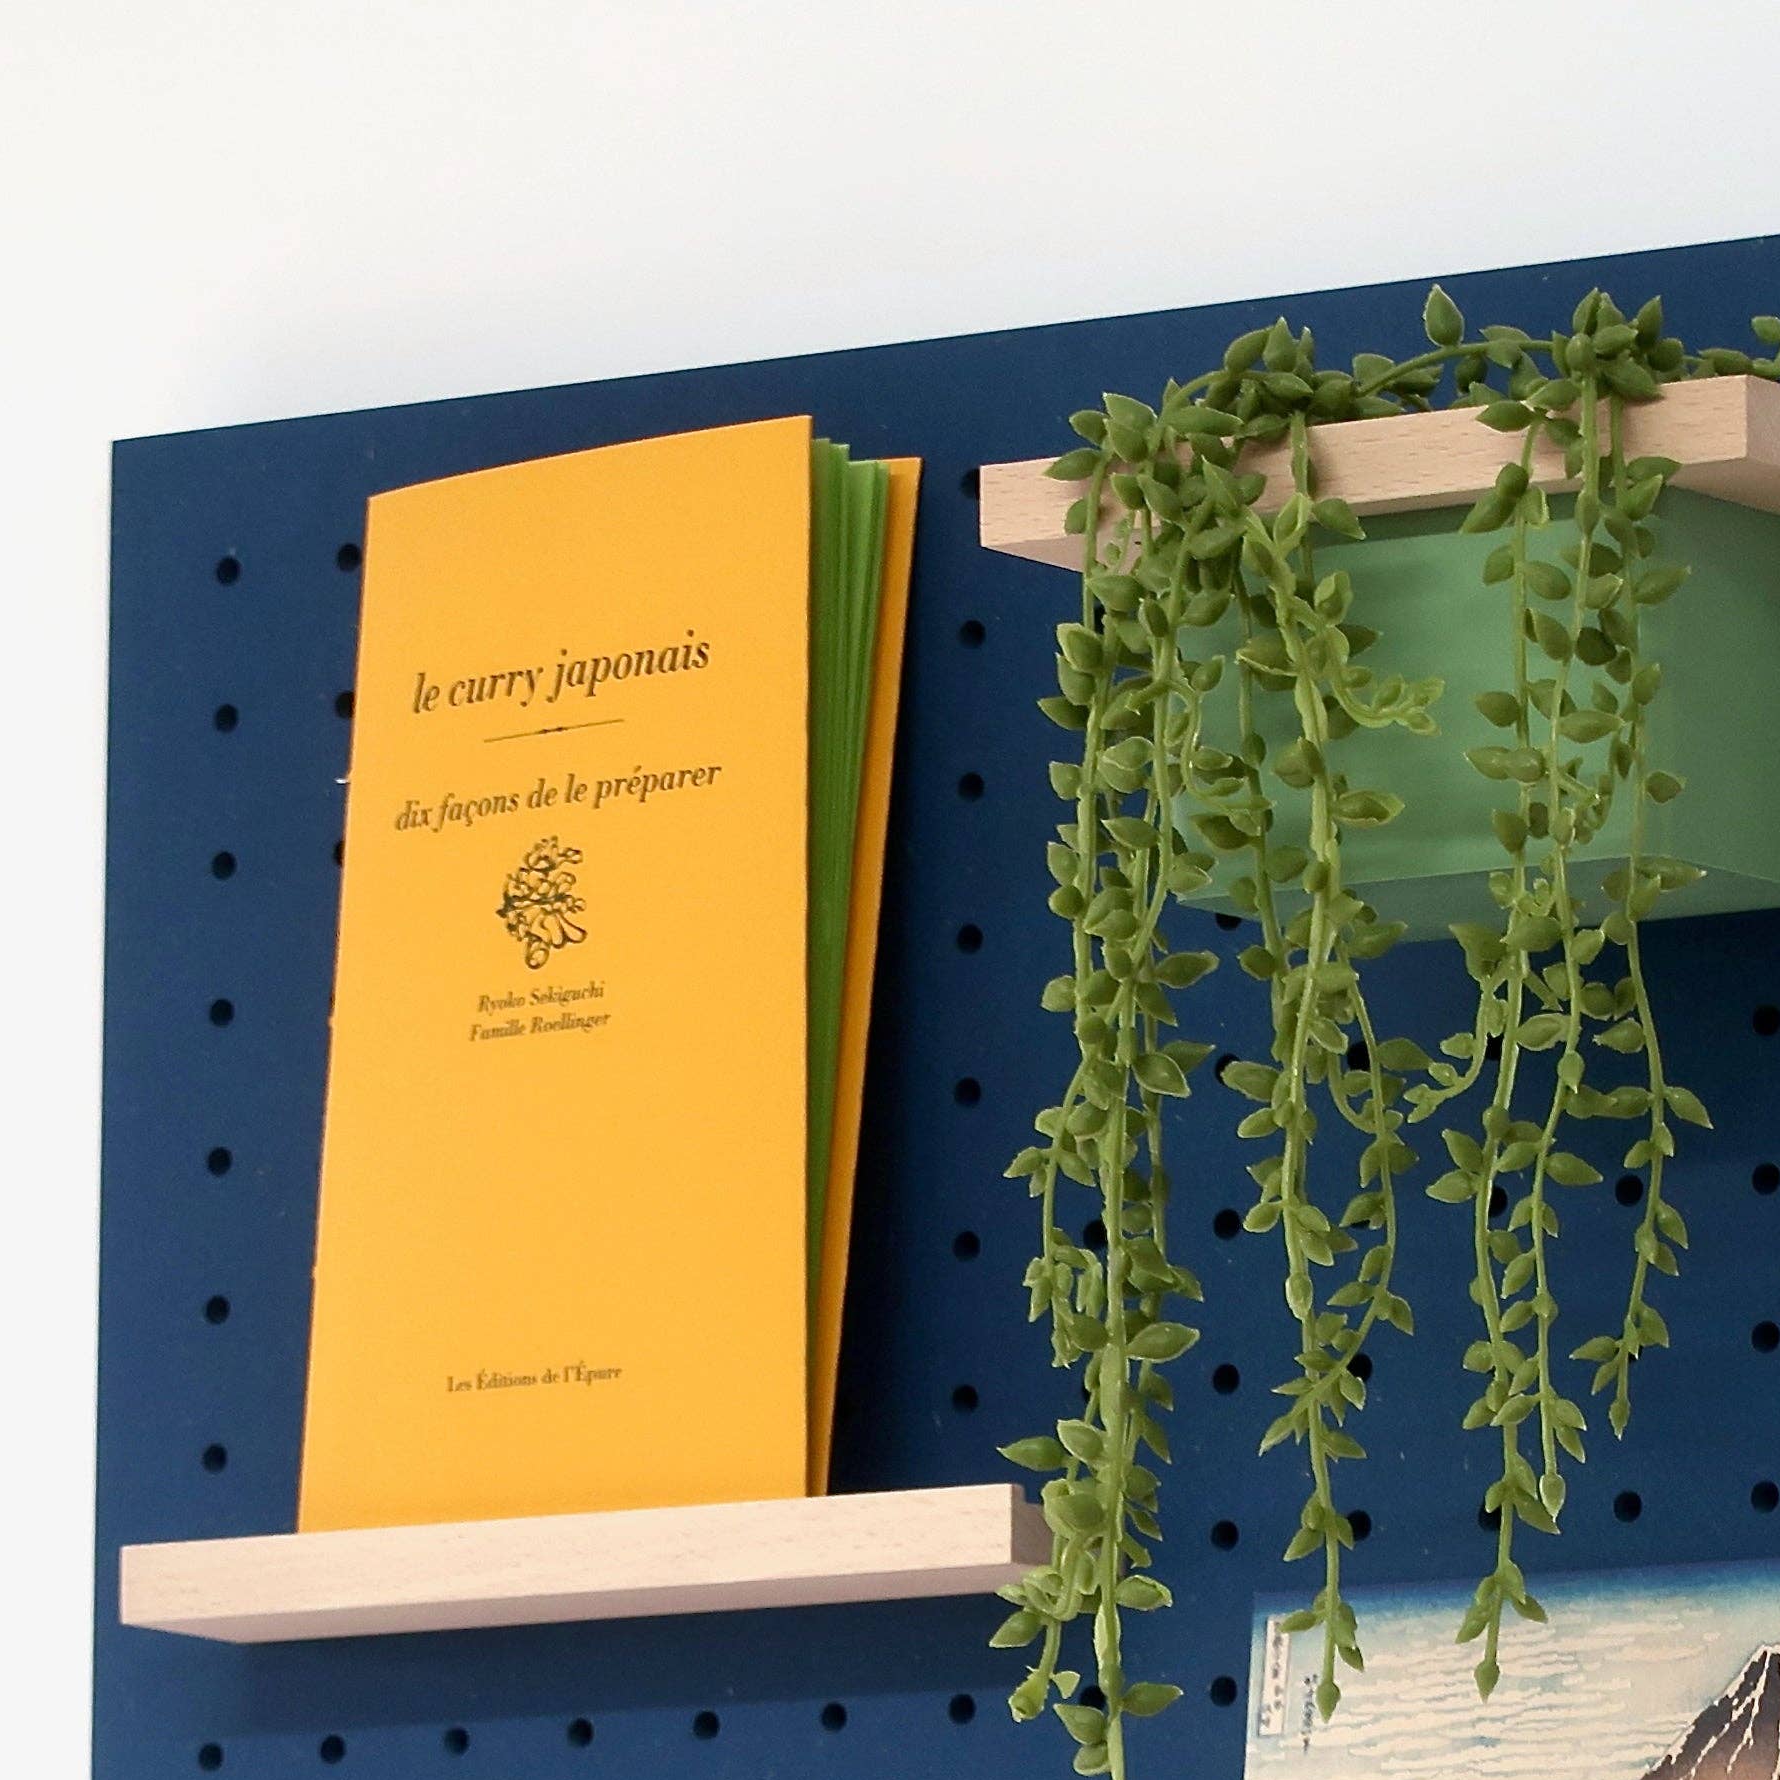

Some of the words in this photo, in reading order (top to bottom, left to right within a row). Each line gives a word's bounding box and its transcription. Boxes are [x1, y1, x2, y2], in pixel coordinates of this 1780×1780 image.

[413, 672, 440, 714] le
[448, 667, 544, 707] curry
[546, 629, 710, 703] japonais
[394, 800, 433, 831] dix
[432, 793, 520, 833] façons
[527, 778, 558, 810] de
[564, 773, 588, 803] le
[592, 765, 722, 809] préparer
[477, 991, 526, 1016] Ryoko
[529, 980, 606, 1006] Sekiguchi
[470, 1019, 527, 1042] Famille
[530, 1012, 611, 1033] Roellinger
[446, 1375, 472, 1392] Les
[476, 1368, 538, 1390] Éditions
[542, 1368, 558, 1384] de
